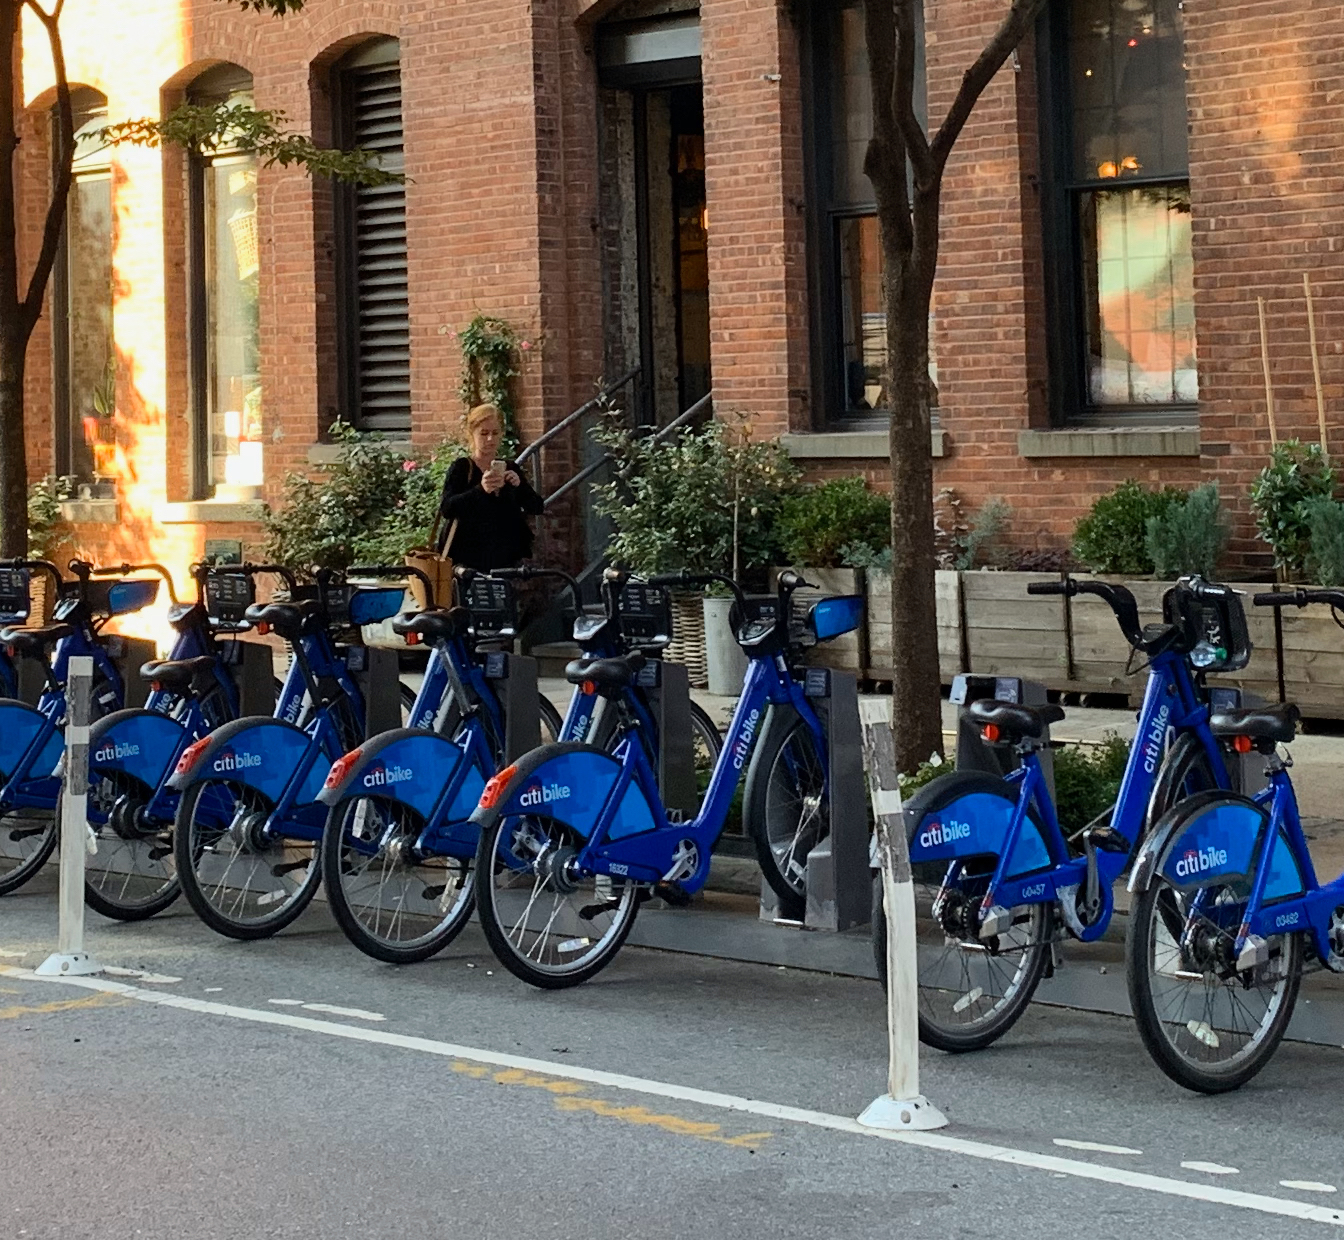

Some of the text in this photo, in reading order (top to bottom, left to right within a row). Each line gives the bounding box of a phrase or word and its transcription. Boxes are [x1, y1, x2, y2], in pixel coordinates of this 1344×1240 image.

[739, 708, 760, 744] bike
[1144, 704, 1170, 774] citi bike
[95, 742, 140, 762] citi bike
[213, 752, 262, 772] citi bike
[363, 765, 413, 788] citi bike
[519, 783, 571, 807] citi bike
[920, 820, 971, 848] citi bike
[1176, 846, 1228, 877] citi bike
